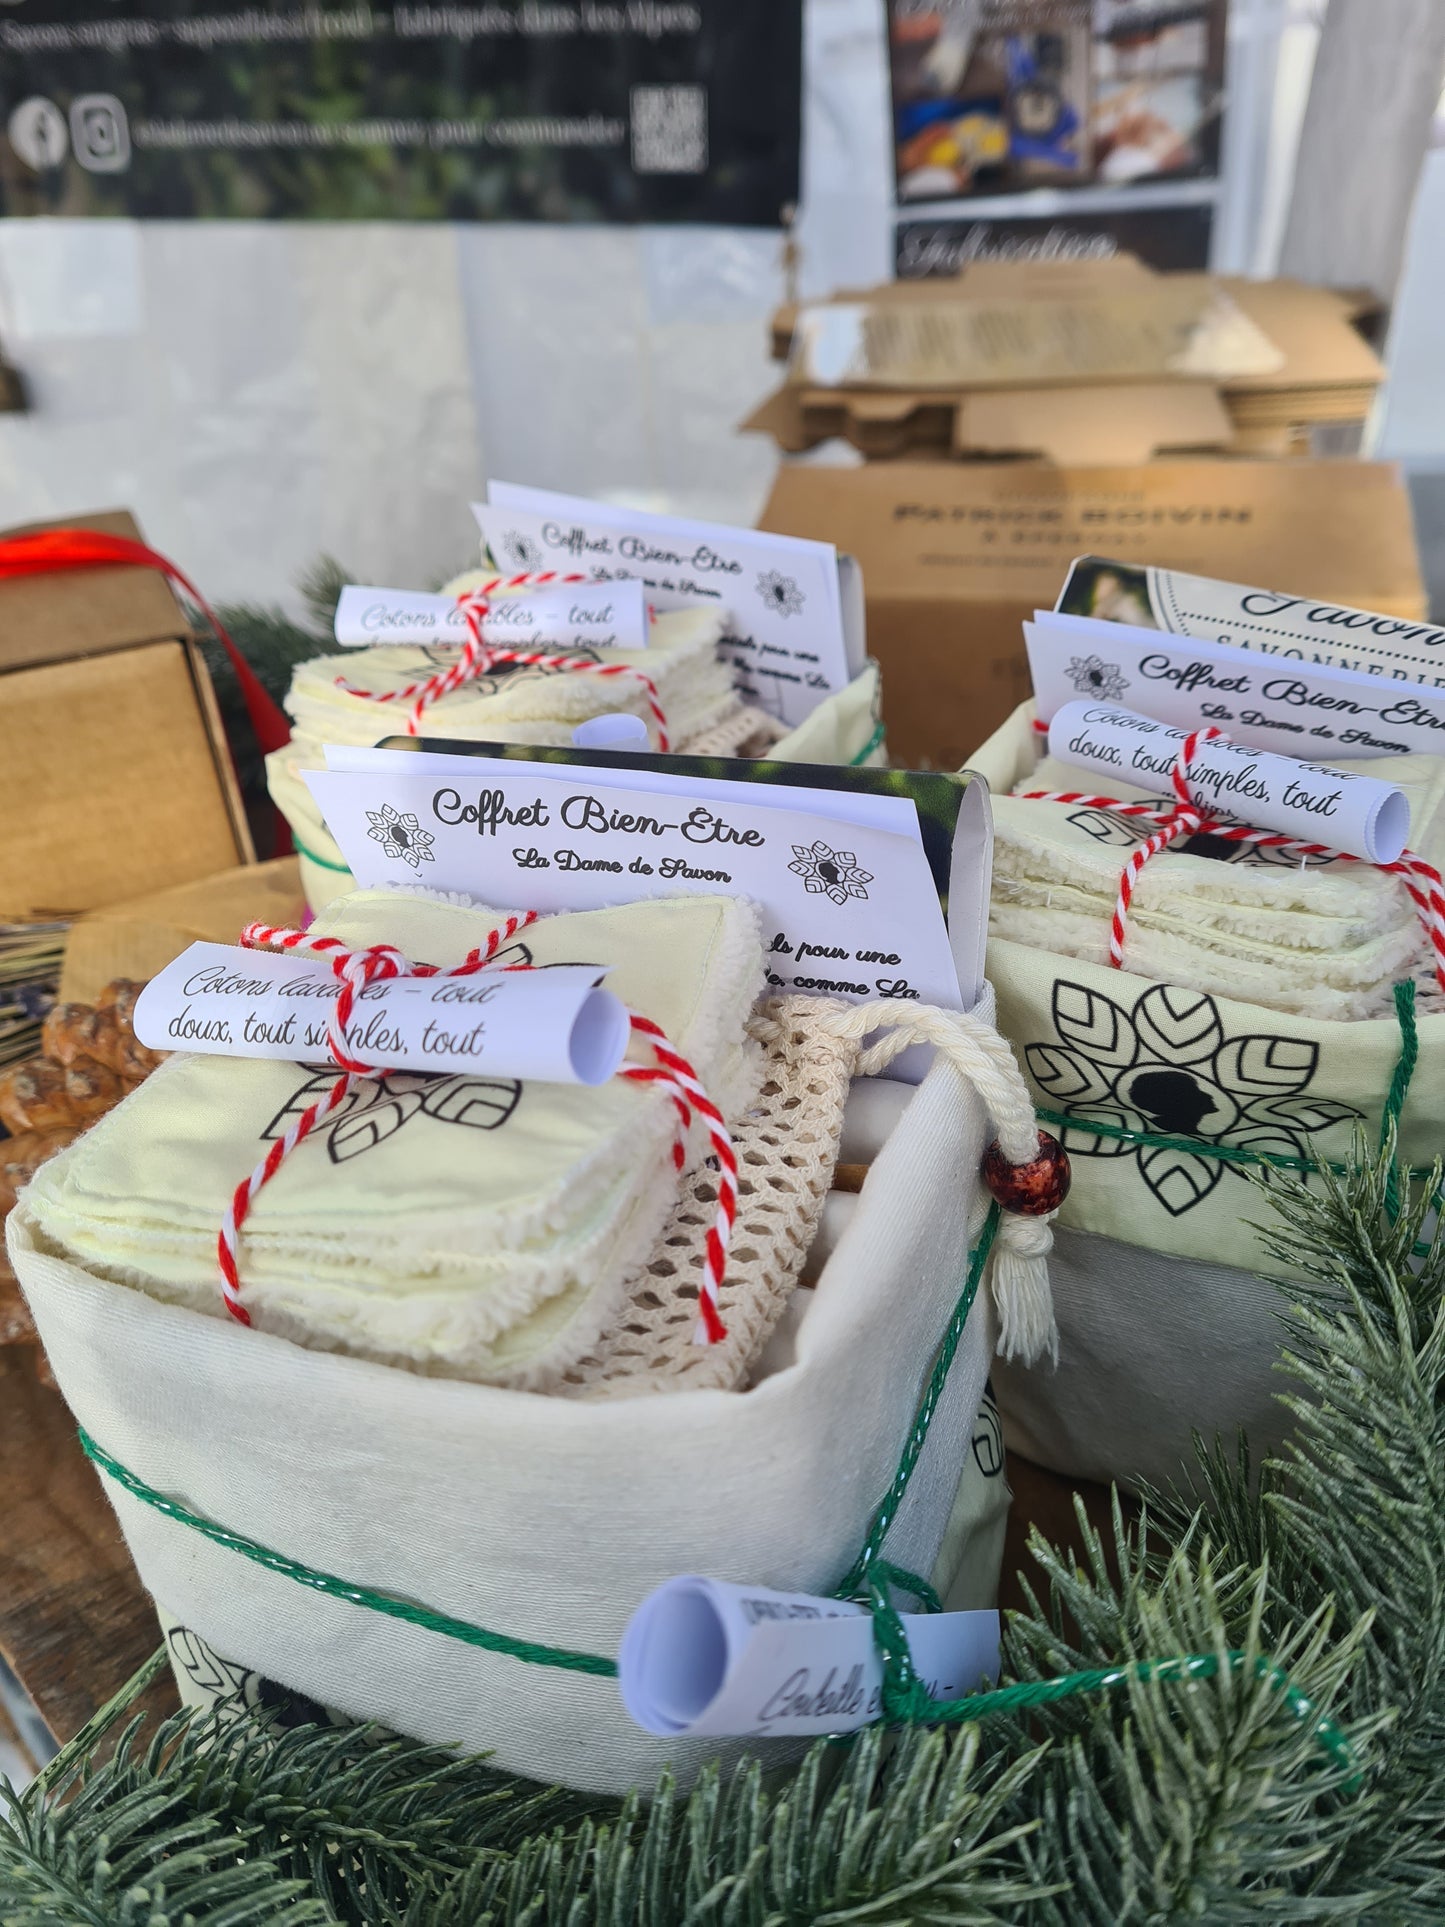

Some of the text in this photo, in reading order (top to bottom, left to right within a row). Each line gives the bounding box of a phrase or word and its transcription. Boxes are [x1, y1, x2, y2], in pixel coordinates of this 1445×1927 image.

[541, 522, 613, 557] Coffret
[446, 601, 534, 627] lables
[569, 603, 614, 625] tout
[1138, 654, 1445, 730] Coffret Bien-Êtr
[1199, 702, 1234, 720] La
[1240, 709, 1305, 733] Dame
[1310, 724, 1334, 739] de
[1069, 729, 1343, 817] doux, tout simples, tout
[433, 788, 766, 847] Coffret Bien-Être
[512, 848, 732, 883] La Dame de Savon
[795, 941, 850, 962] pour
[856, 950, 902, 965] une
[183, 965, 274, 997] Cotons
[277, 973, 393, 1001] lavaes
[431, 979, 506, 1005] tout
[793, 975, 871, 995] comme
[168, 1004, 486, 1057] doux, tout siples, tout
